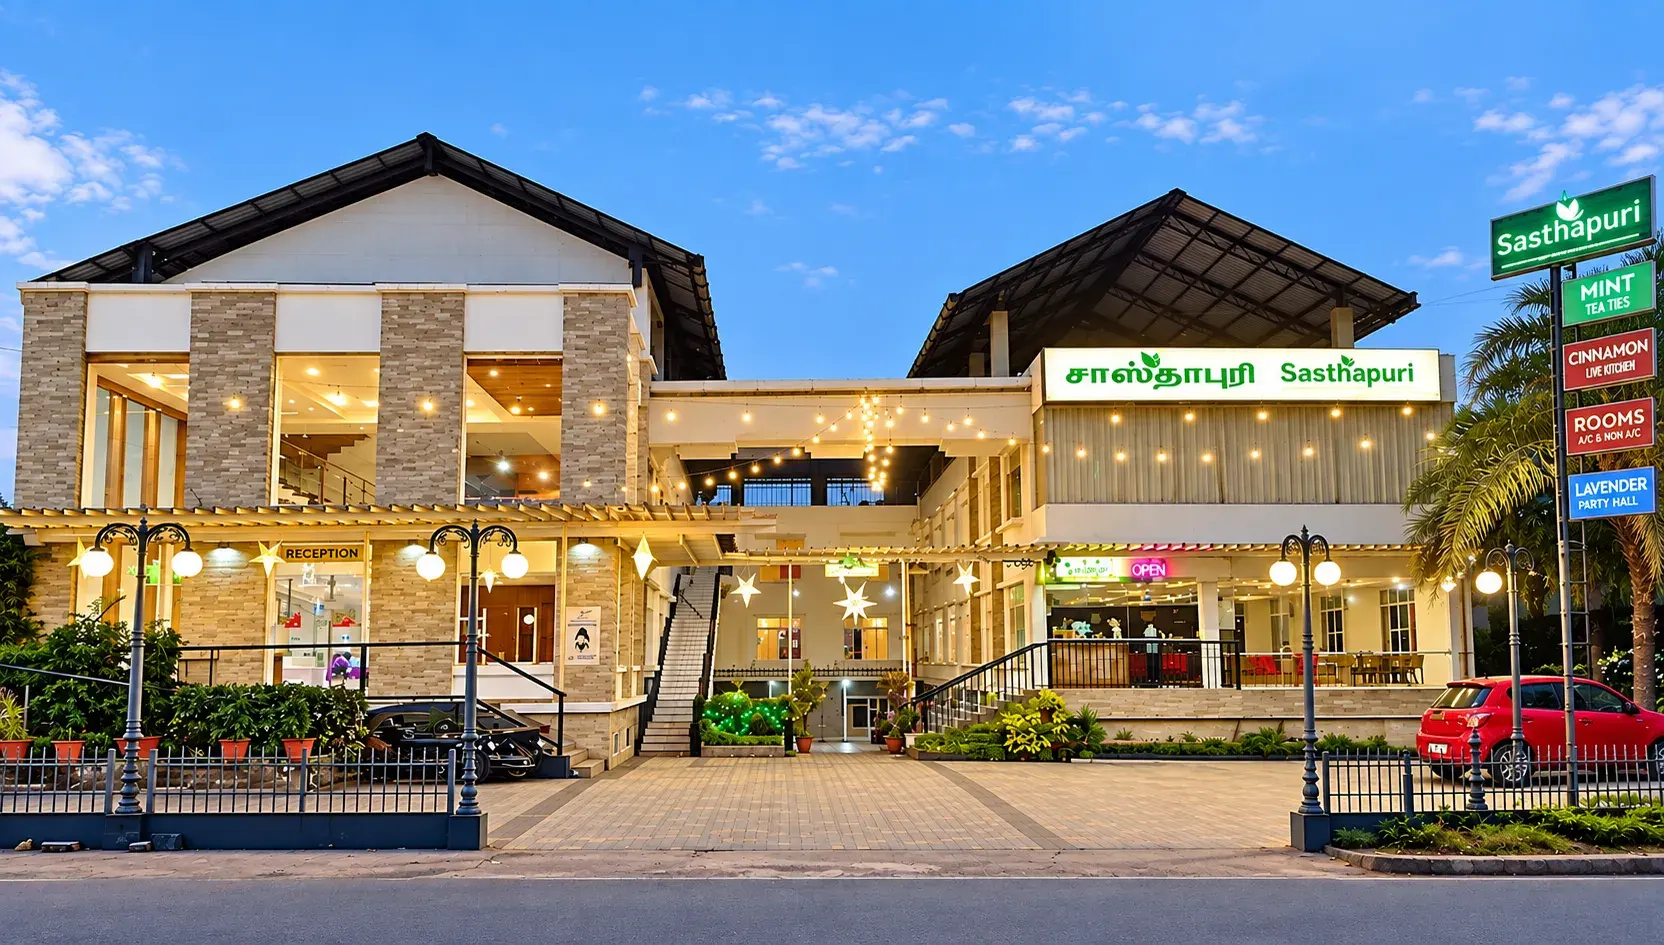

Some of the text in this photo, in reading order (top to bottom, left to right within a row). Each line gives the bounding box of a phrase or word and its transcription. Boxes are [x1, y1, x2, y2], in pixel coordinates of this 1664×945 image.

[1497, 198, 1641, 256] Sasthapuri
[1580, 272, 1636, 302] MINT
[1585, 295, 1631, 316] TEA TIES
[1568, 338, 1649, 366] CINNAMON
[1065, 360, 1255, 390] சாஸ்தாபுரி
[1280, 362, 1414, 388] Sasthapuri
[1585, 365, 1603, 379] LIVE
[1573, 408, 1645, 433] ROOMS
[1577, 427, 1641, 445] A/C & NON A/C
[1575, 477, 1648, 498] LAVENDER
[1578, 495, 1638, 510] PARTY HALL
[285, 548, 359, 559] RECEPTION
[1131, 563, 1166, 577] OPEN
